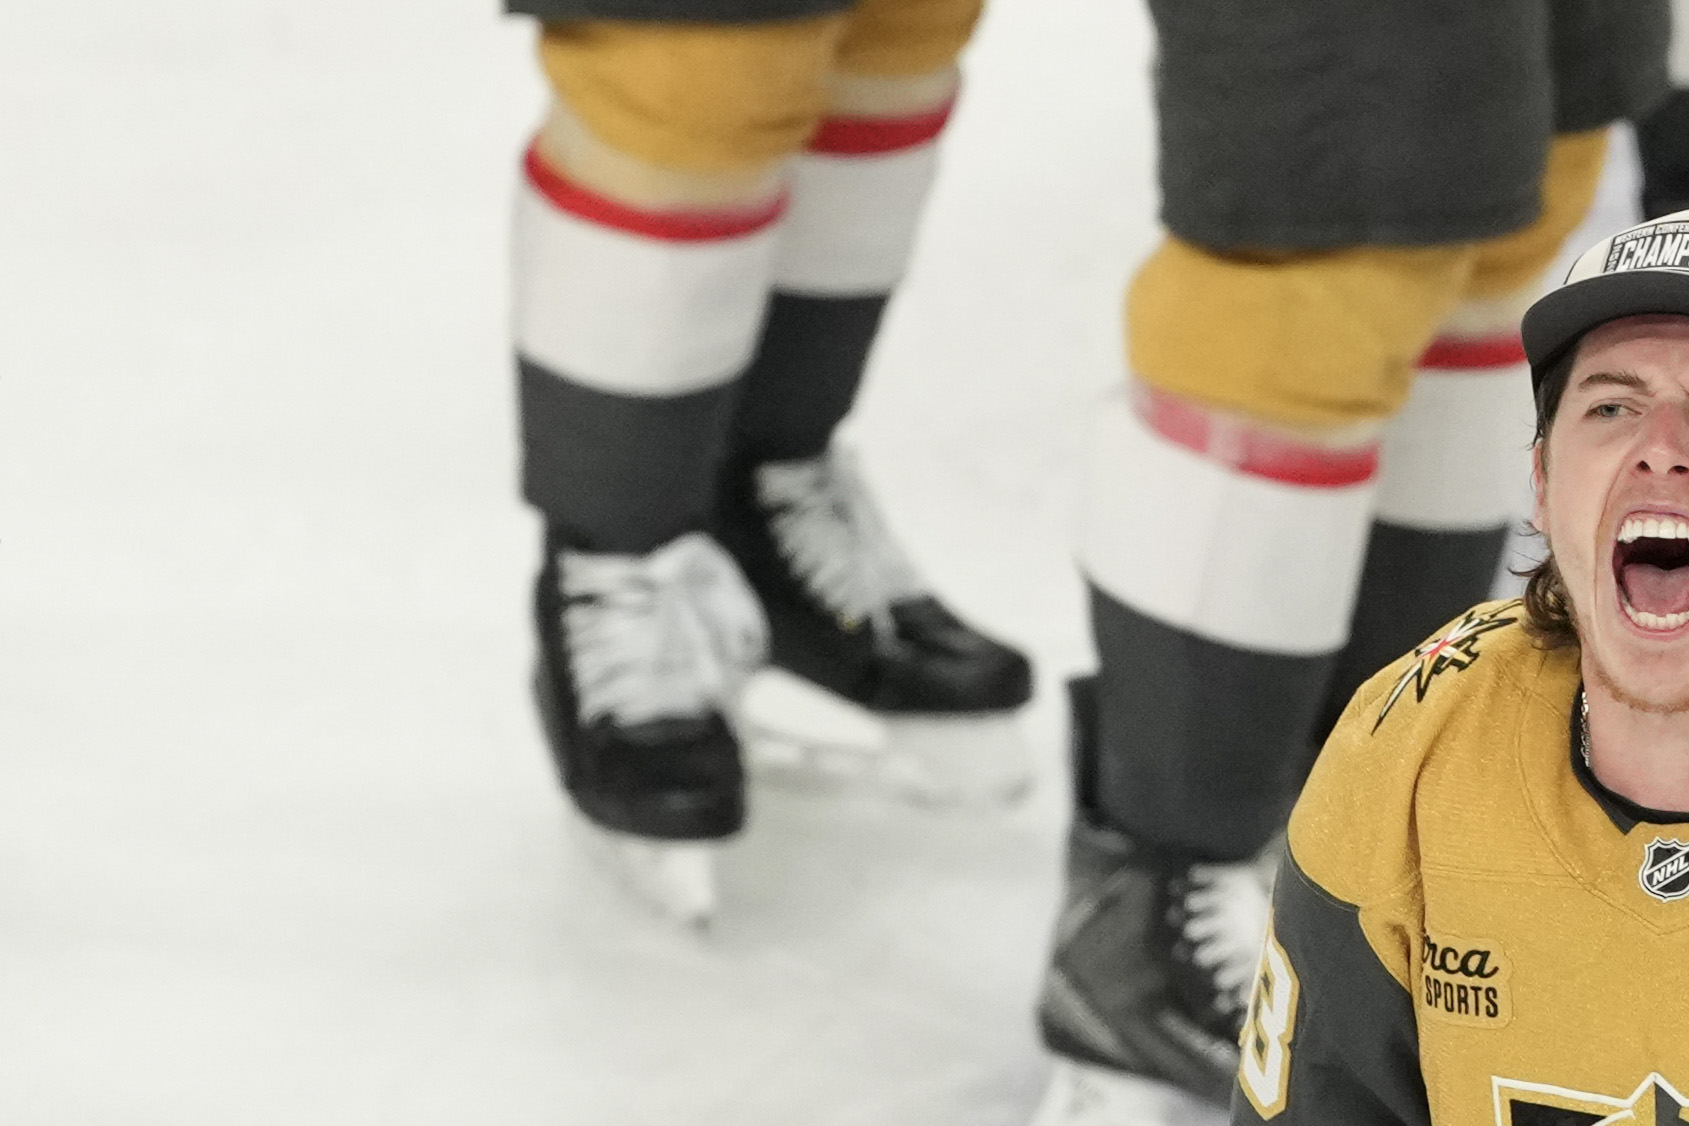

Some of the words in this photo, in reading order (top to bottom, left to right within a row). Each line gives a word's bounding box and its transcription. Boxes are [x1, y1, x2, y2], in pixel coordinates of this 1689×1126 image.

[1652, 855, 1689, 886] NHL
[1422, 934, 1499, 979] rca
[1425, 975, 1498, 1018] SPORTS
